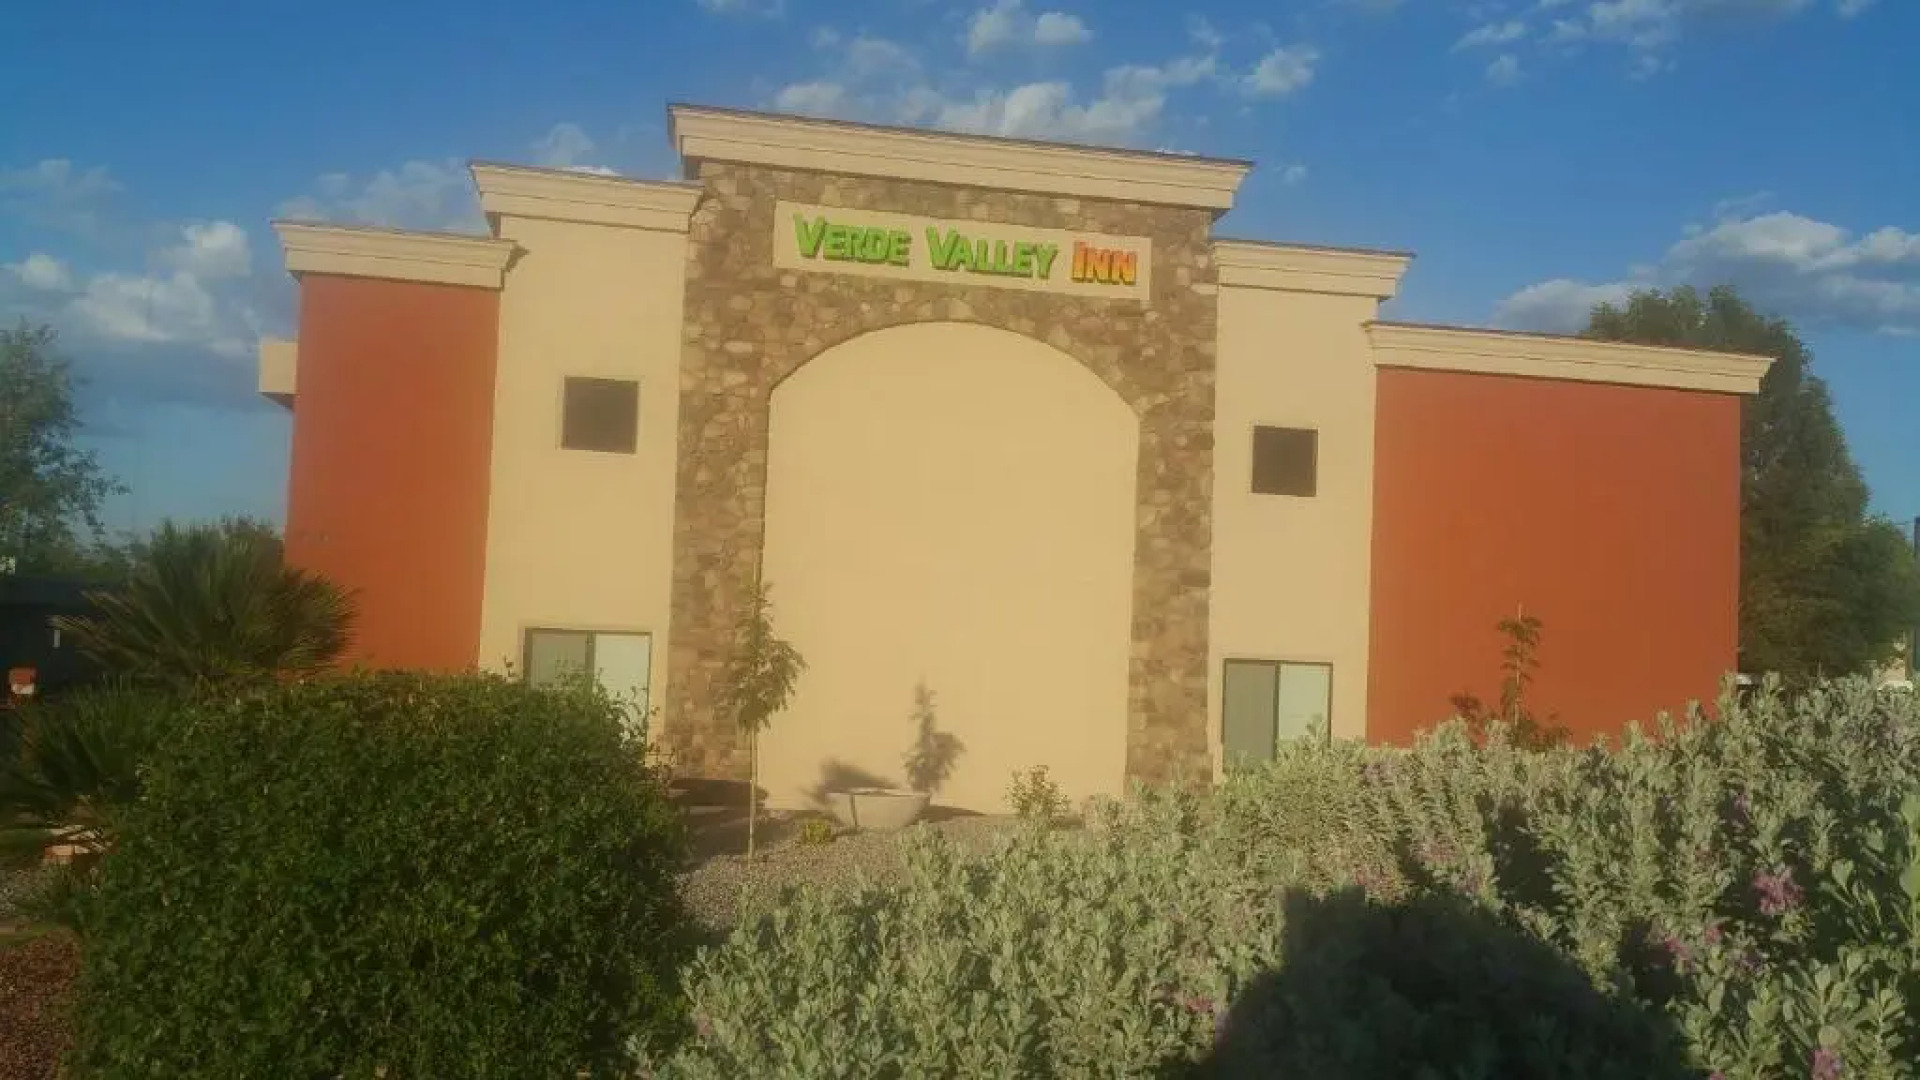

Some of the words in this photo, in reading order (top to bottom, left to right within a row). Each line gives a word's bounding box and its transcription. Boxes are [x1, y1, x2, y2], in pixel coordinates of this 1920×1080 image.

[794, 213, 911, 266] VERDE
[925, 225, 1058, 279] VALLEY
[1071, 240, 1136, 285] INN
